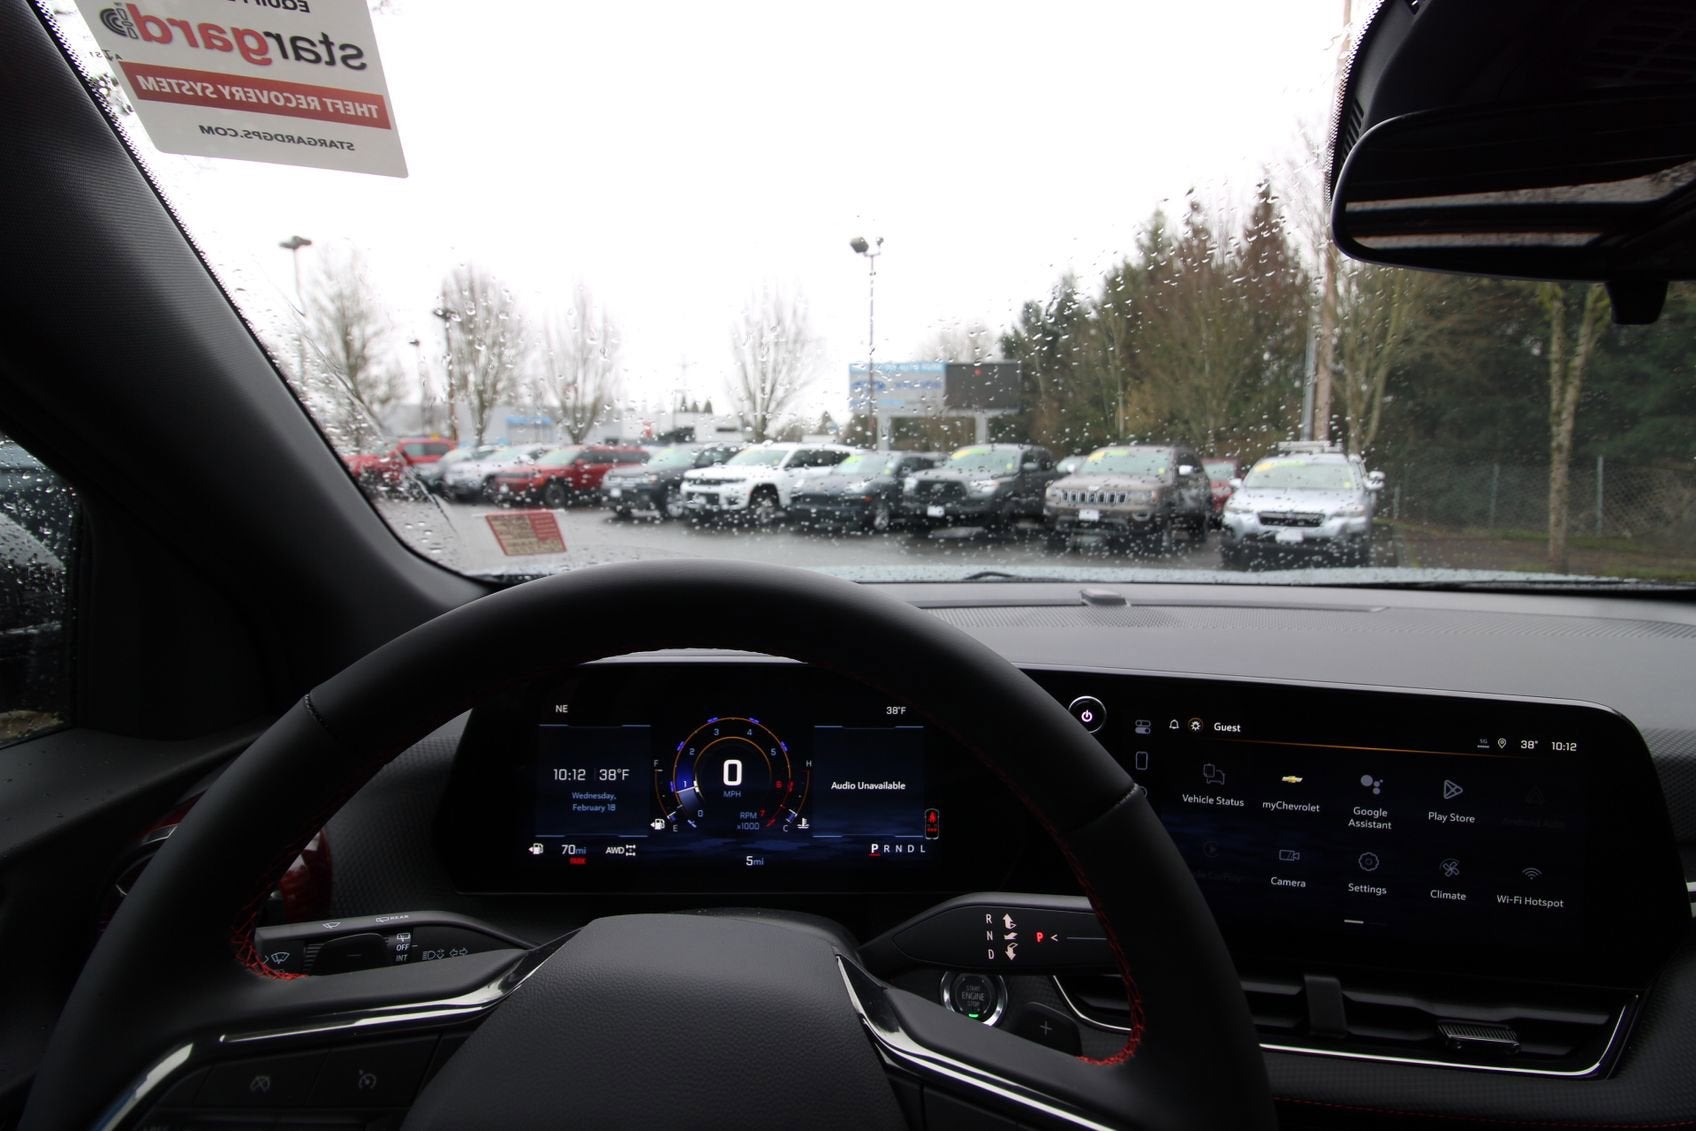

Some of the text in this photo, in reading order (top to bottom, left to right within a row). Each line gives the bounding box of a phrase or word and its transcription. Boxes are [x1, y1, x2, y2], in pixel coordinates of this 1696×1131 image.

[555, 704, 568, 713] NE
[1213, 722, 1241, 732] Guest
[1520, 739, 1539, 750] 38°
[1551, 741, 1577, 752] 10:12
[553, 768, 630, 781] 10:12 38°F
[723, 759, 742, 786] 0
[831, 781, 906, 790] Audio Unavailable
[723, 790, 741, 798] MPH
[1182, 794, 1244, 807] Vehicle Status
[1262, 800, 1320, 812] myChevrolet
[572, 803, 616, 813] February 18
[1353, 806, 1388, 818] Google
[740, 811, 757, 819] RPM
[1428, 811, 1475, 824] Play Store
[1348, 819, 1392, 830] Assistant
[605, 846, 625, 854] AWD
[1270, 877, 1306, 888] Camera
[1348, 883, 1387, 896] Settings
[1430, 890, 1466, 900] Climate
[1497, 894, 1564, 909] Wi-Fi Hotspot
[985, 913, 993, 924] R
[986, 931, 993, 941] N
[1036, 932, 1044, 942] P
[396, 943, 409, 951] OFF
[988, 949, 994, 960] D
[962, 992, 985, 1001] ENGINE
